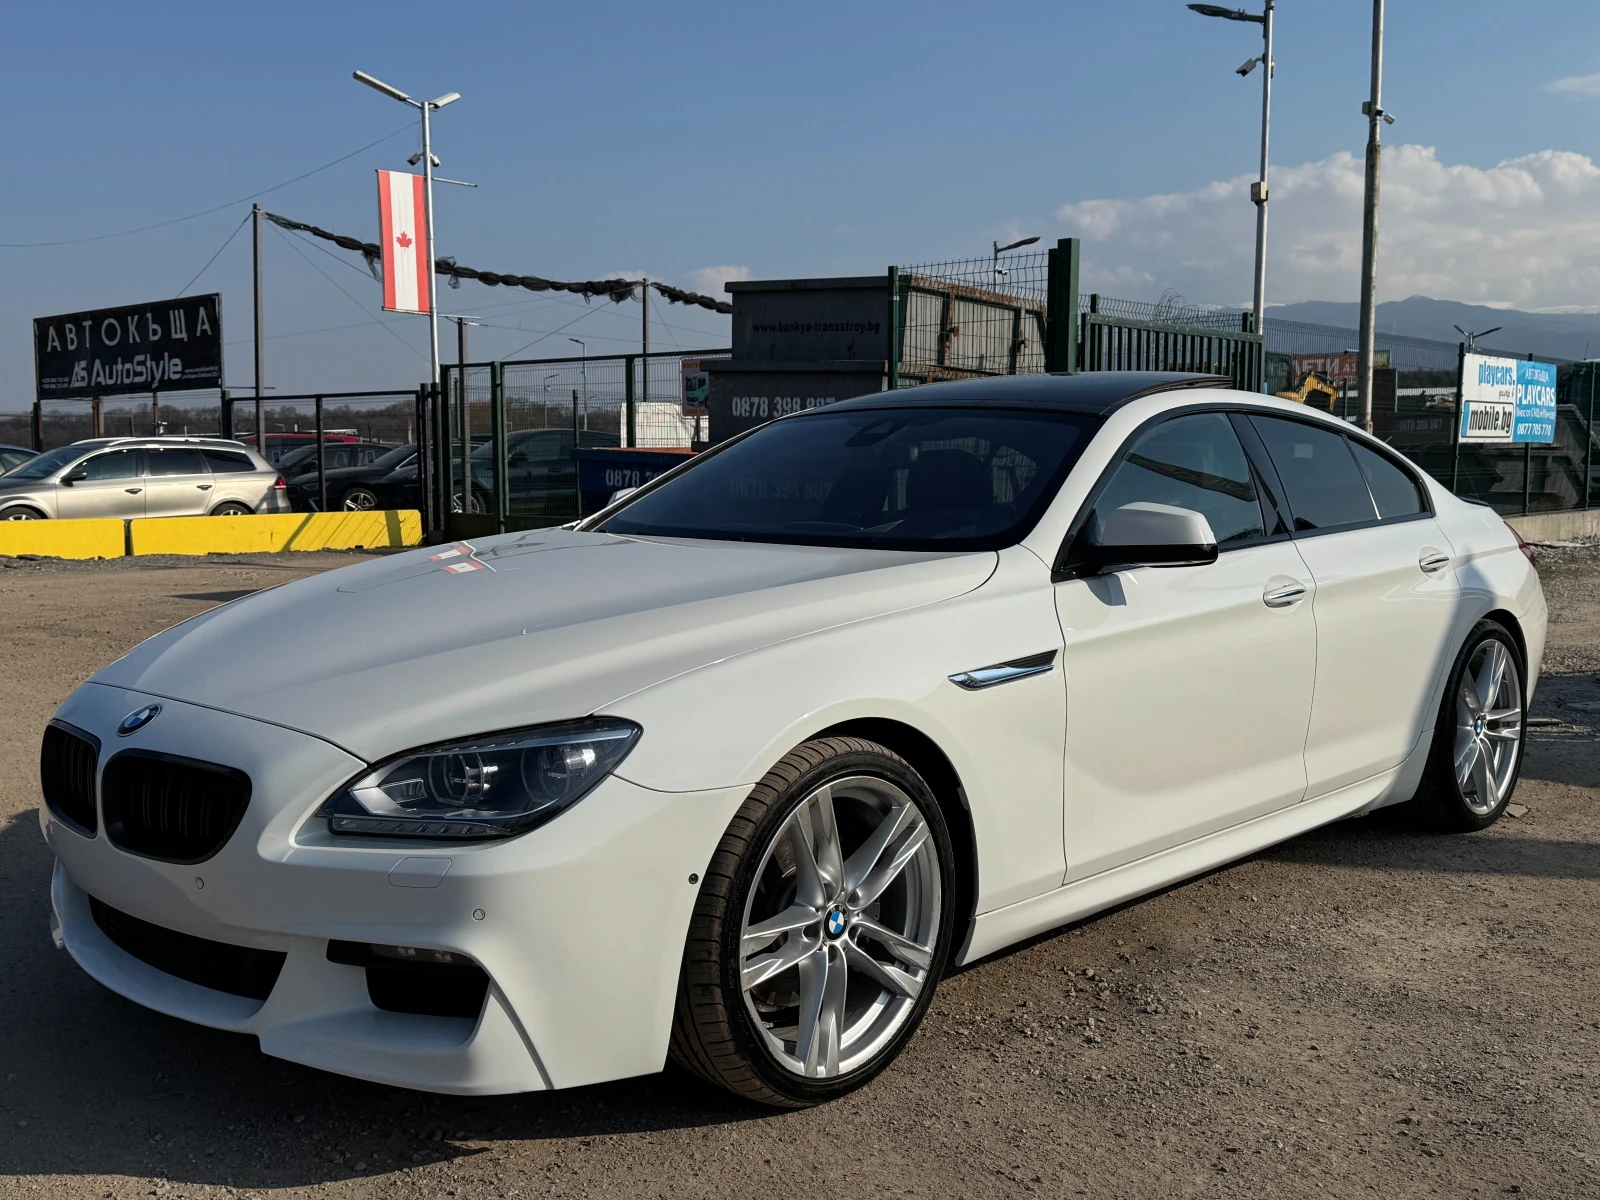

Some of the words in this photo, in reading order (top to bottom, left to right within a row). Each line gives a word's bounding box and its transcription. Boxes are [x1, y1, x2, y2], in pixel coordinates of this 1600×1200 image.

[46, 306, 212, 352] АВТОКЪЩА
[752, 321, 880, 335] www.bankya-transstroy.bg
[91, 352, 183, 389] AutoStyle
[1517, 384, 1555, 407] PLAYCARS
[732, 396, 769, 418] 0878
[1469, 405, 1513, 434] mobile.bg
[1517, 423, 1532, 435] 0877
[605, 468, 640, 488] 0878
